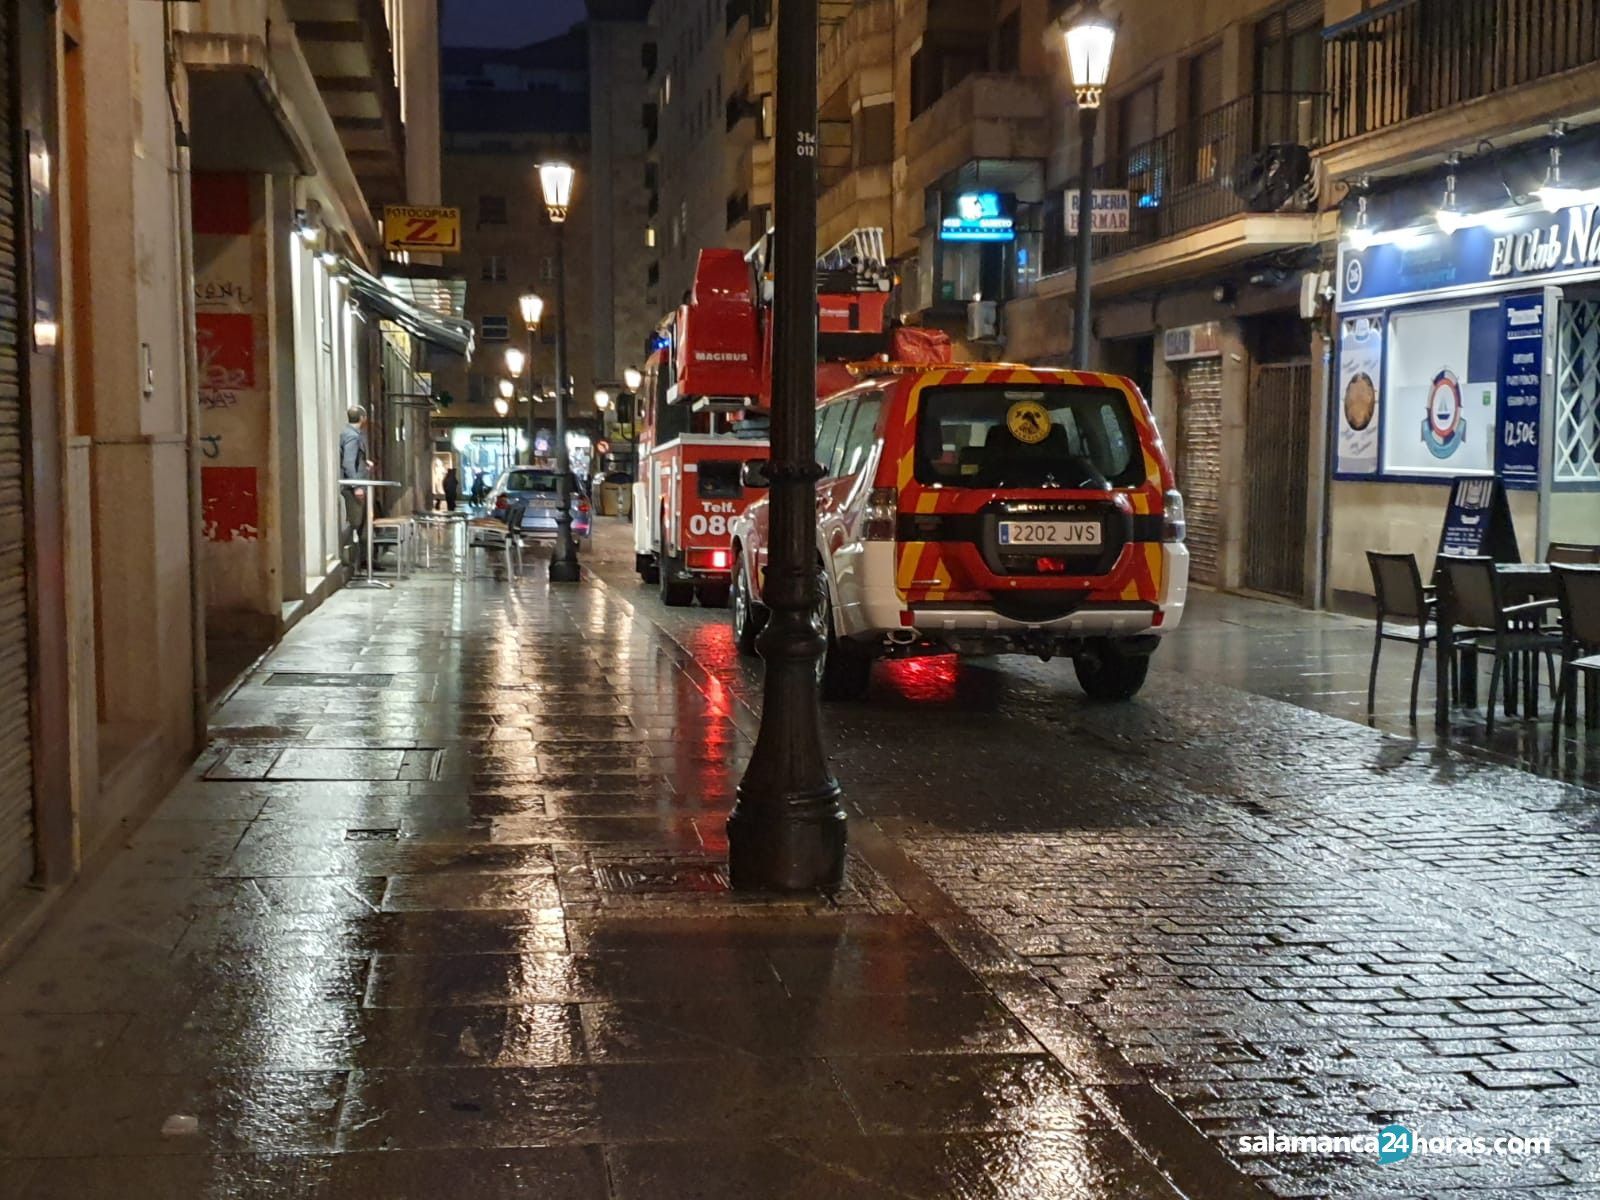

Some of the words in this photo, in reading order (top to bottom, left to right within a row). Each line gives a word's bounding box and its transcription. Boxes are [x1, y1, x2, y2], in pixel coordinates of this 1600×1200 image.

[405, 218, 438, 242] Z
[1489, 234, 1514, 277] El
[1515, 223, 1561, 272] Club
[696, 352, 748, 361] MAGIRUS
[701, 501, 736, 513] Telf.
[1013, 525, 1057, 541] 2202
[1064, 525, 1095, 541] JVS
